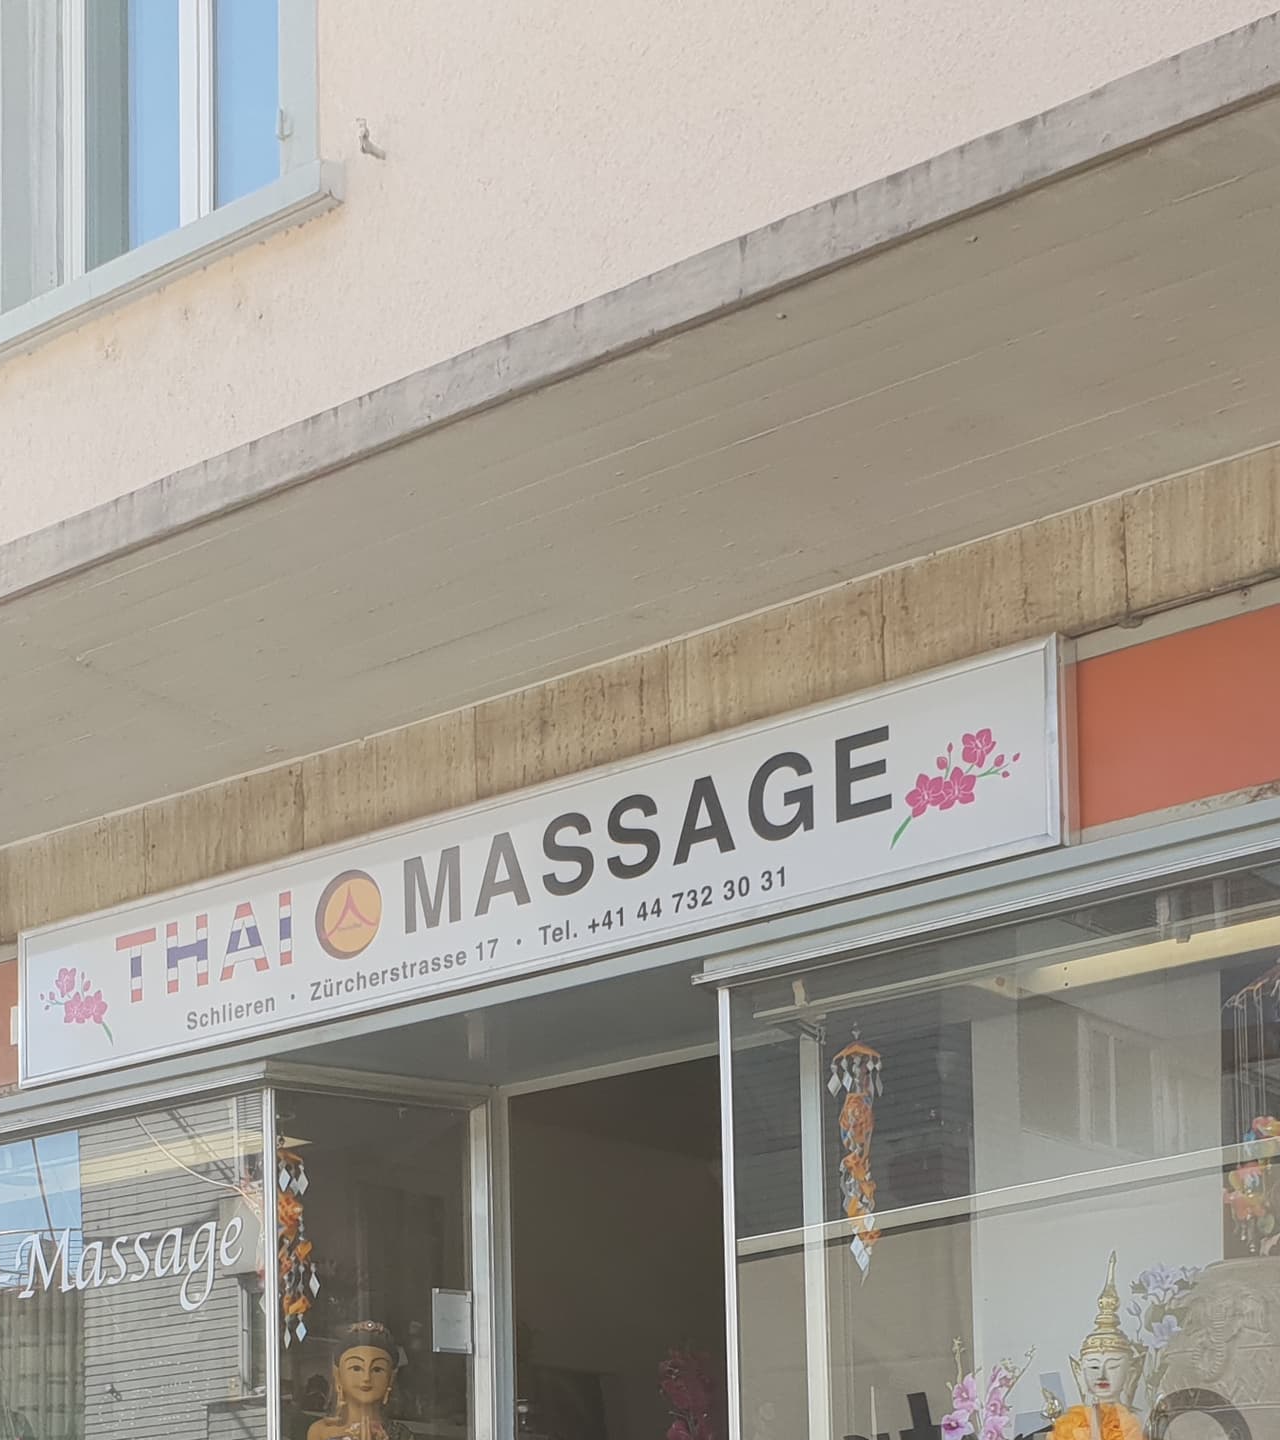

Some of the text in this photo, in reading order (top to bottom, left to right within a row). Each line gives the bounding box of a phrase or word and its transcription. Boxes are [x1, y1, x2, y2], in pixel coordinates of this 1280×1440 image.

[115, 725, 893, 1003] THAI MASSAGE
[186, 866, 787, 1031] Schlieren Zürcherstrasse 17 Tel. +41 44 732 30 31
